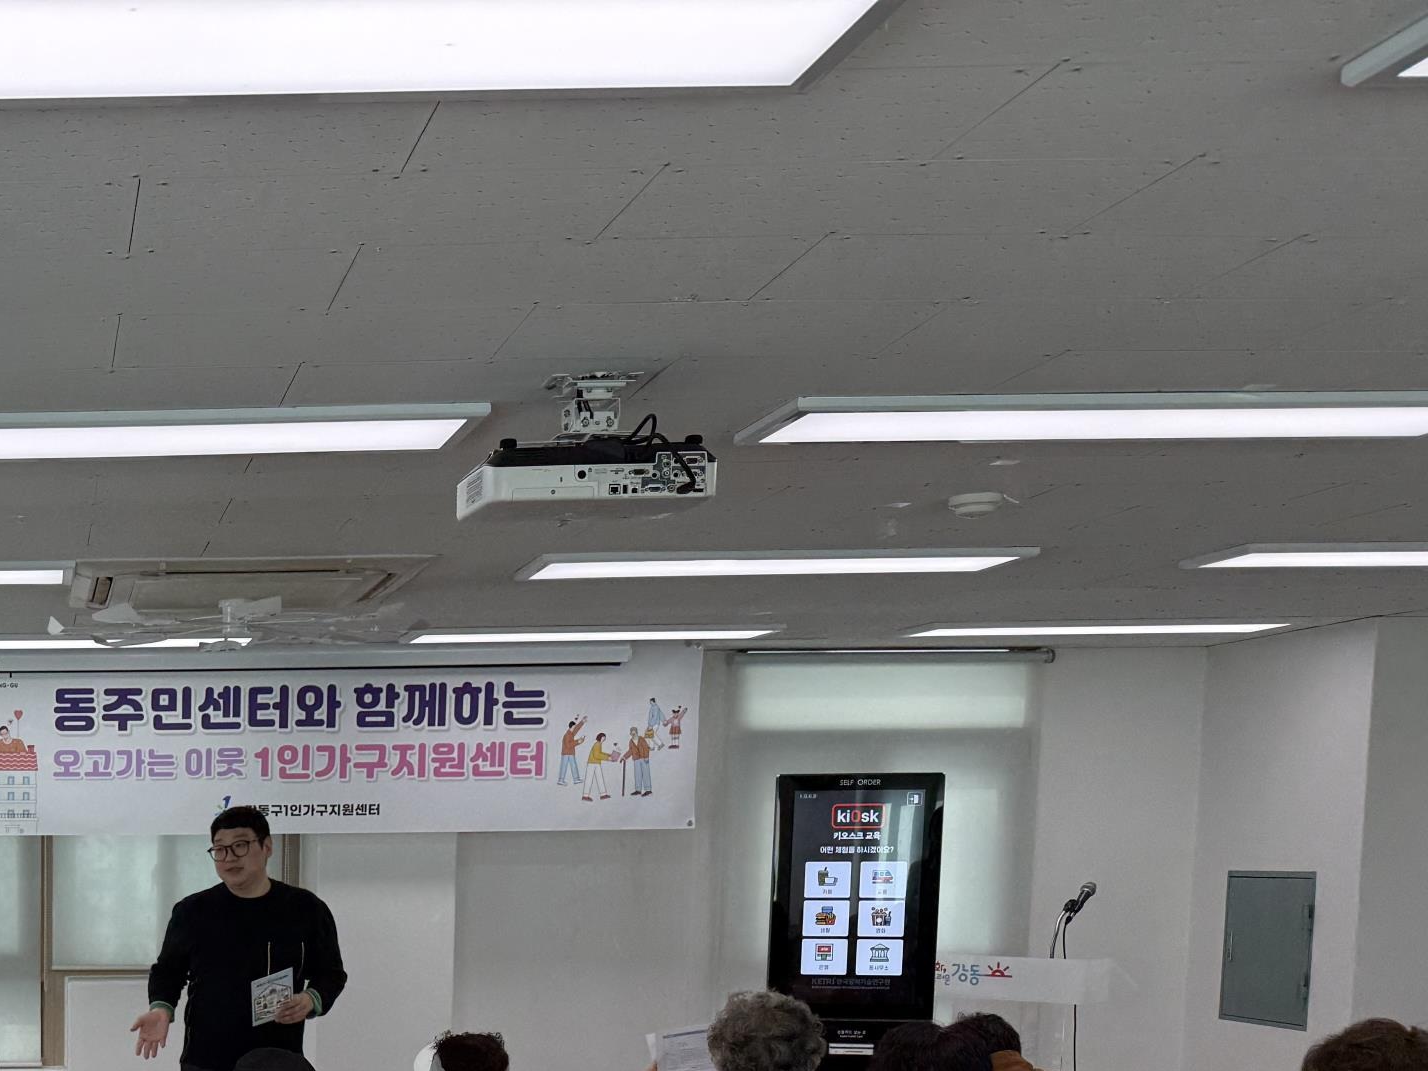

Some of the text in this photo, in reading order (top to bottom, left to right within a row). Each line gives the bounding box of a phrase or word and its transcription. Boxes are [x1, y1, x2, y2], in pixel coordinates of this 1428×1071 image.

[53, 681, 547, 732] 동주민센터와 함께하는
[52, 740, 545, 780] 오고가는 이웃 1인가구지원센터
[833, 831, 865, 841] 키오스크
[952, 963, 980, 986] 강동
